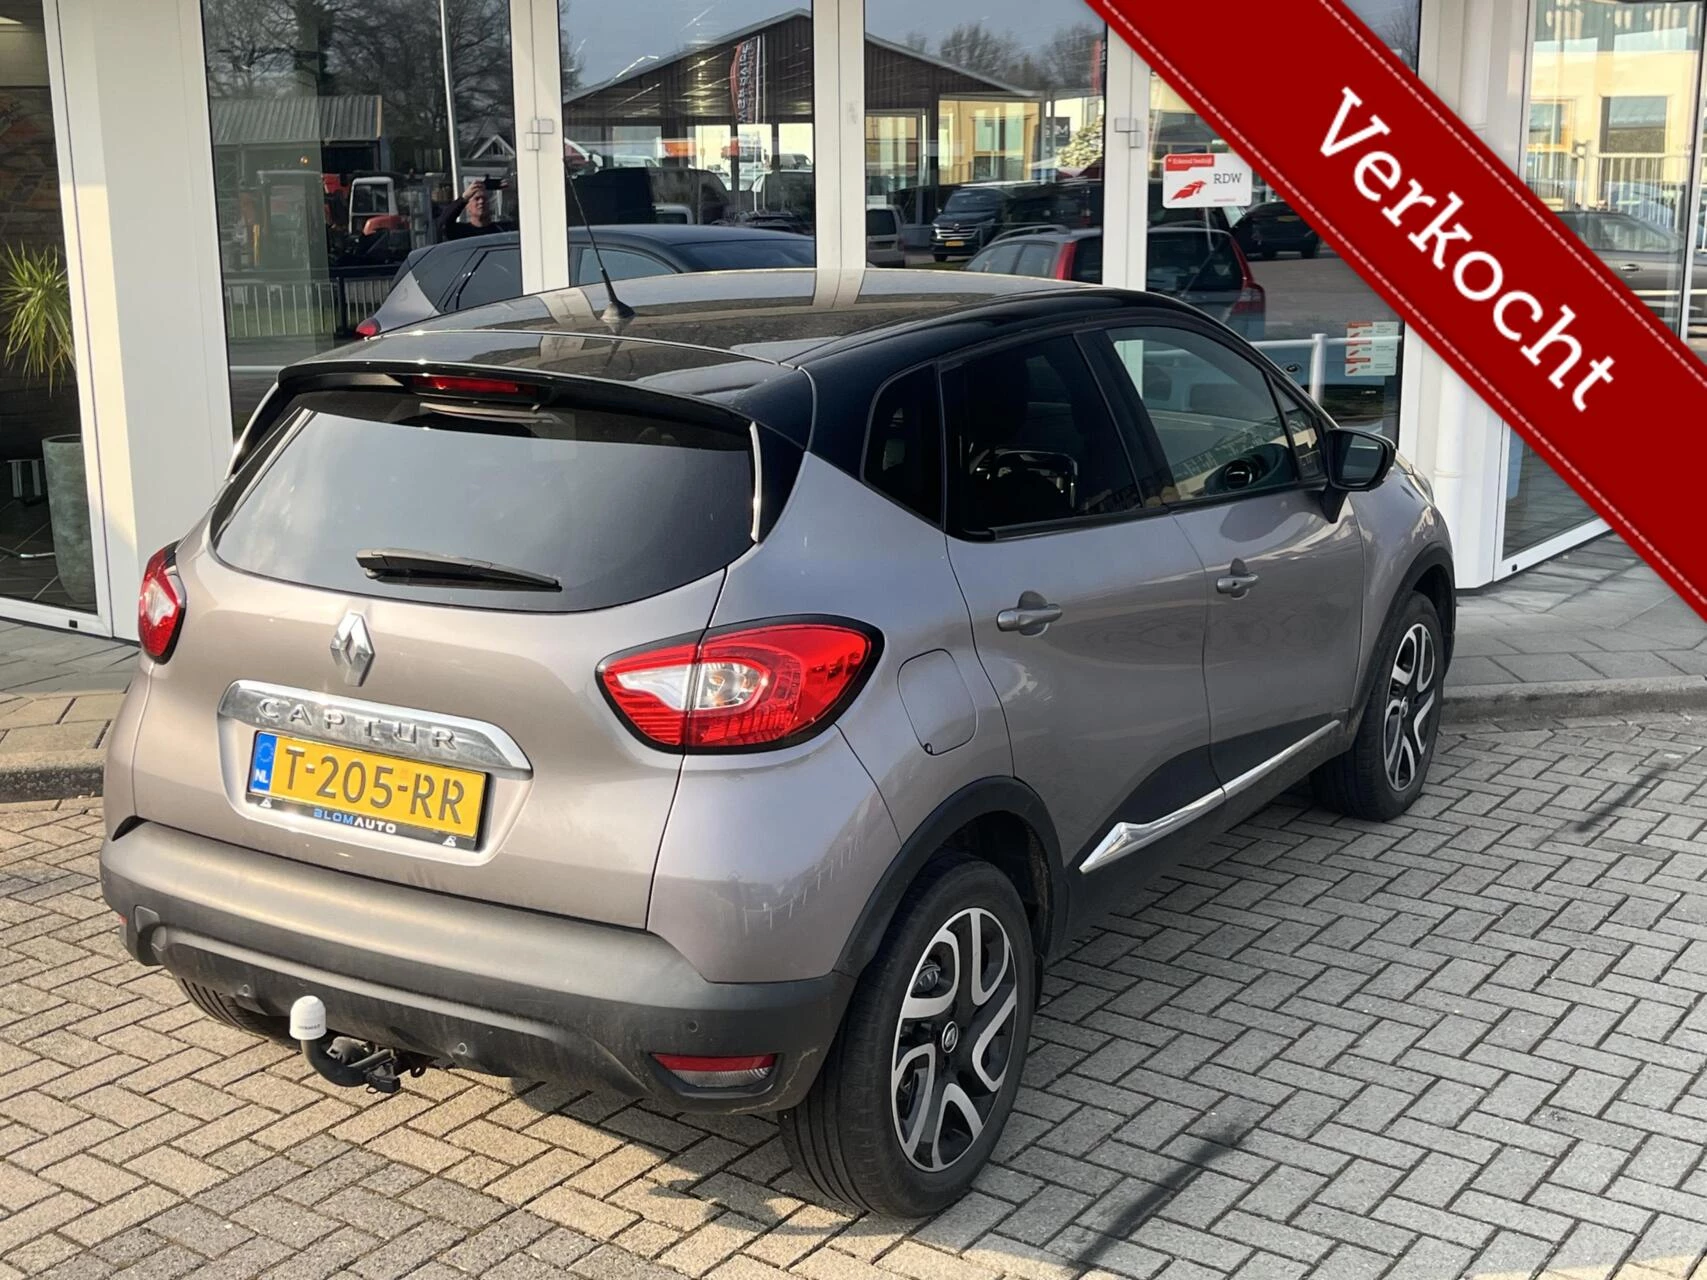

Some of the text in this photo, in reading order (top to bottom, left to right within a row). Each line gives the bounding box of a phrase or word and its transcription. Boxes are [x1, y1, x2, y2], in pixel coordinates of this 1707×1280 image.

[1213, 173, 1242, 184] RDW
[258, 699, 458, 751] CAPTUR
[254, 769, 269, 784] NL
[286, 747, 466, 825] T-205-RR
[313, 808, 397, 834] BLOMAUTO
